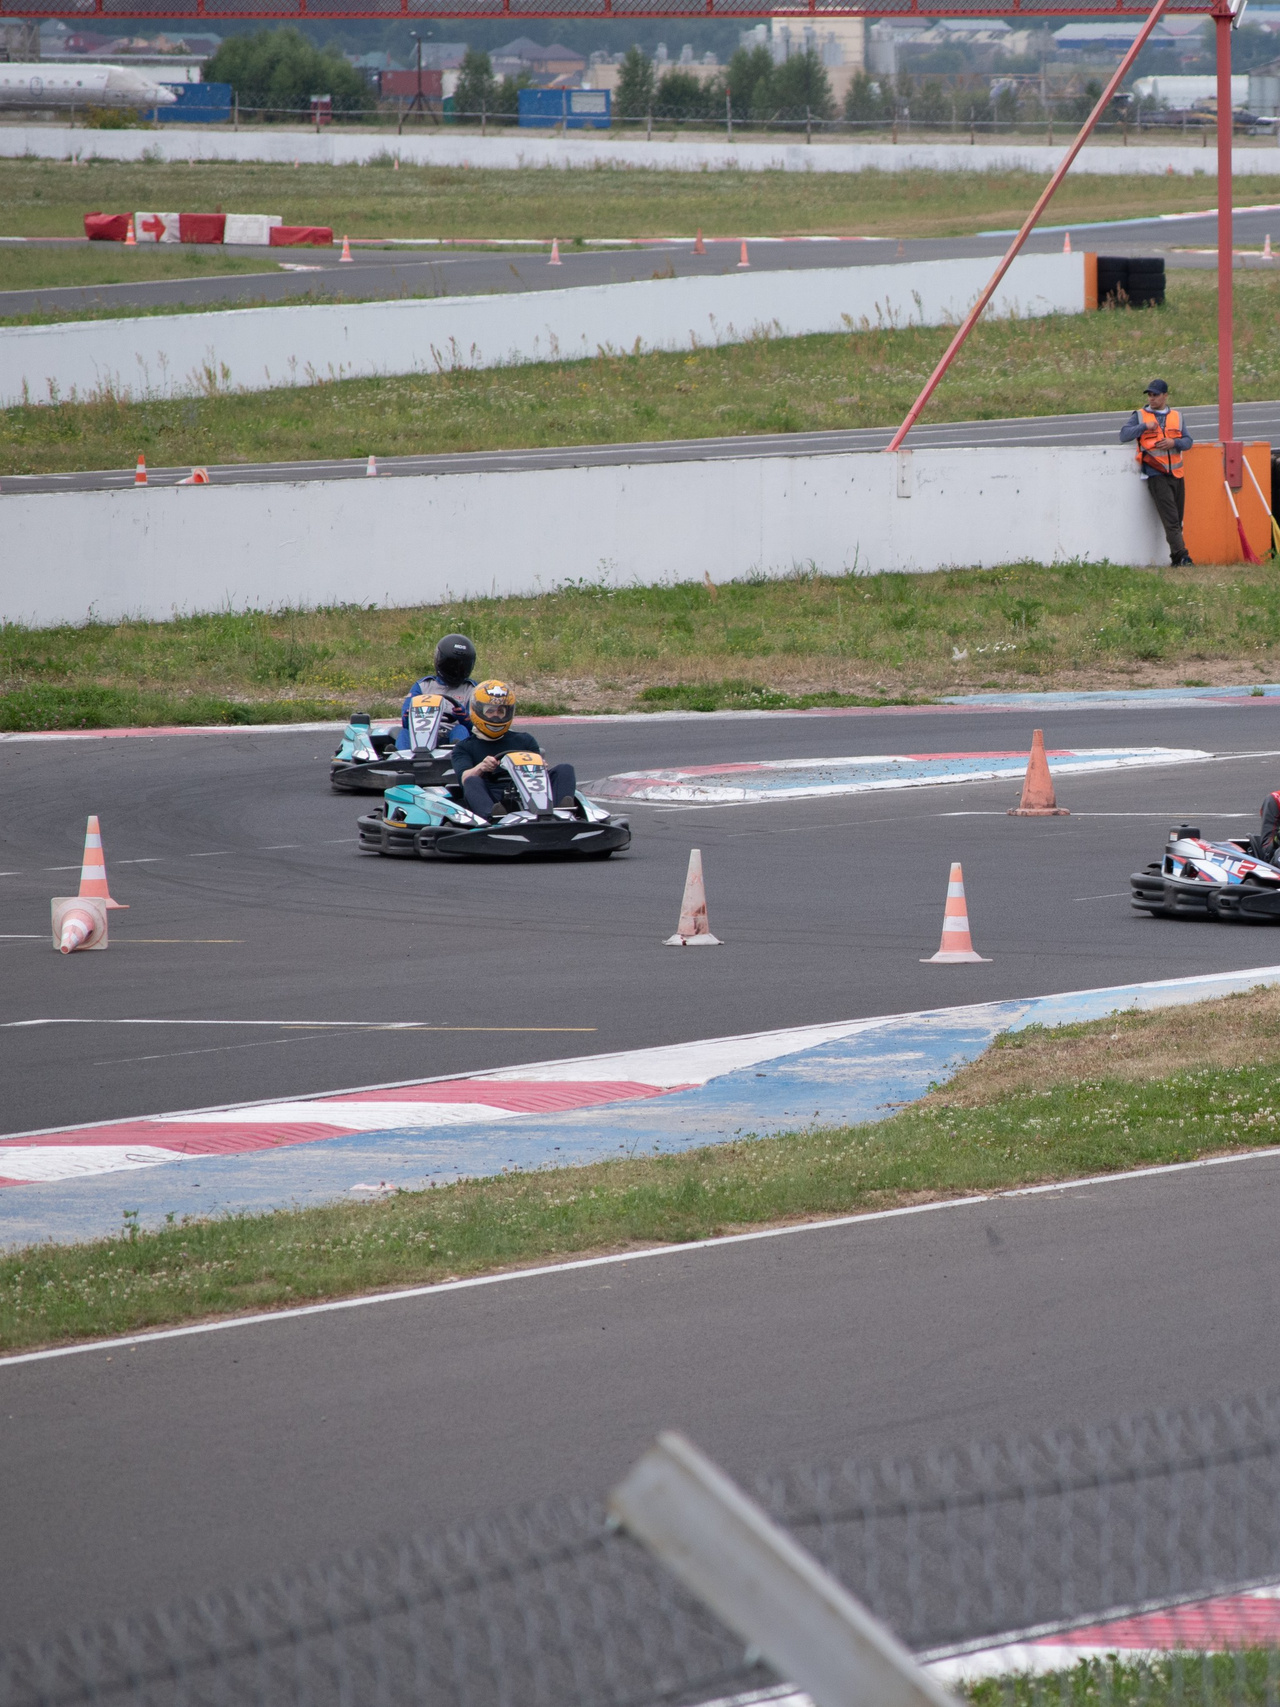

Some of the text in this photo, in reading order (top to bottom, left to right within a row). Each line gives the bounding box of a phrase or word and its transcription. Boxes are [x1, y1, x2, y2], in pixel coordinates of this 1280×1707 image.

[421, 695, 432, 704] 2
[415, 718, 432, 732] 2
[520, 753, 533, 761] 3
[527, 778, 545, 792] 3
